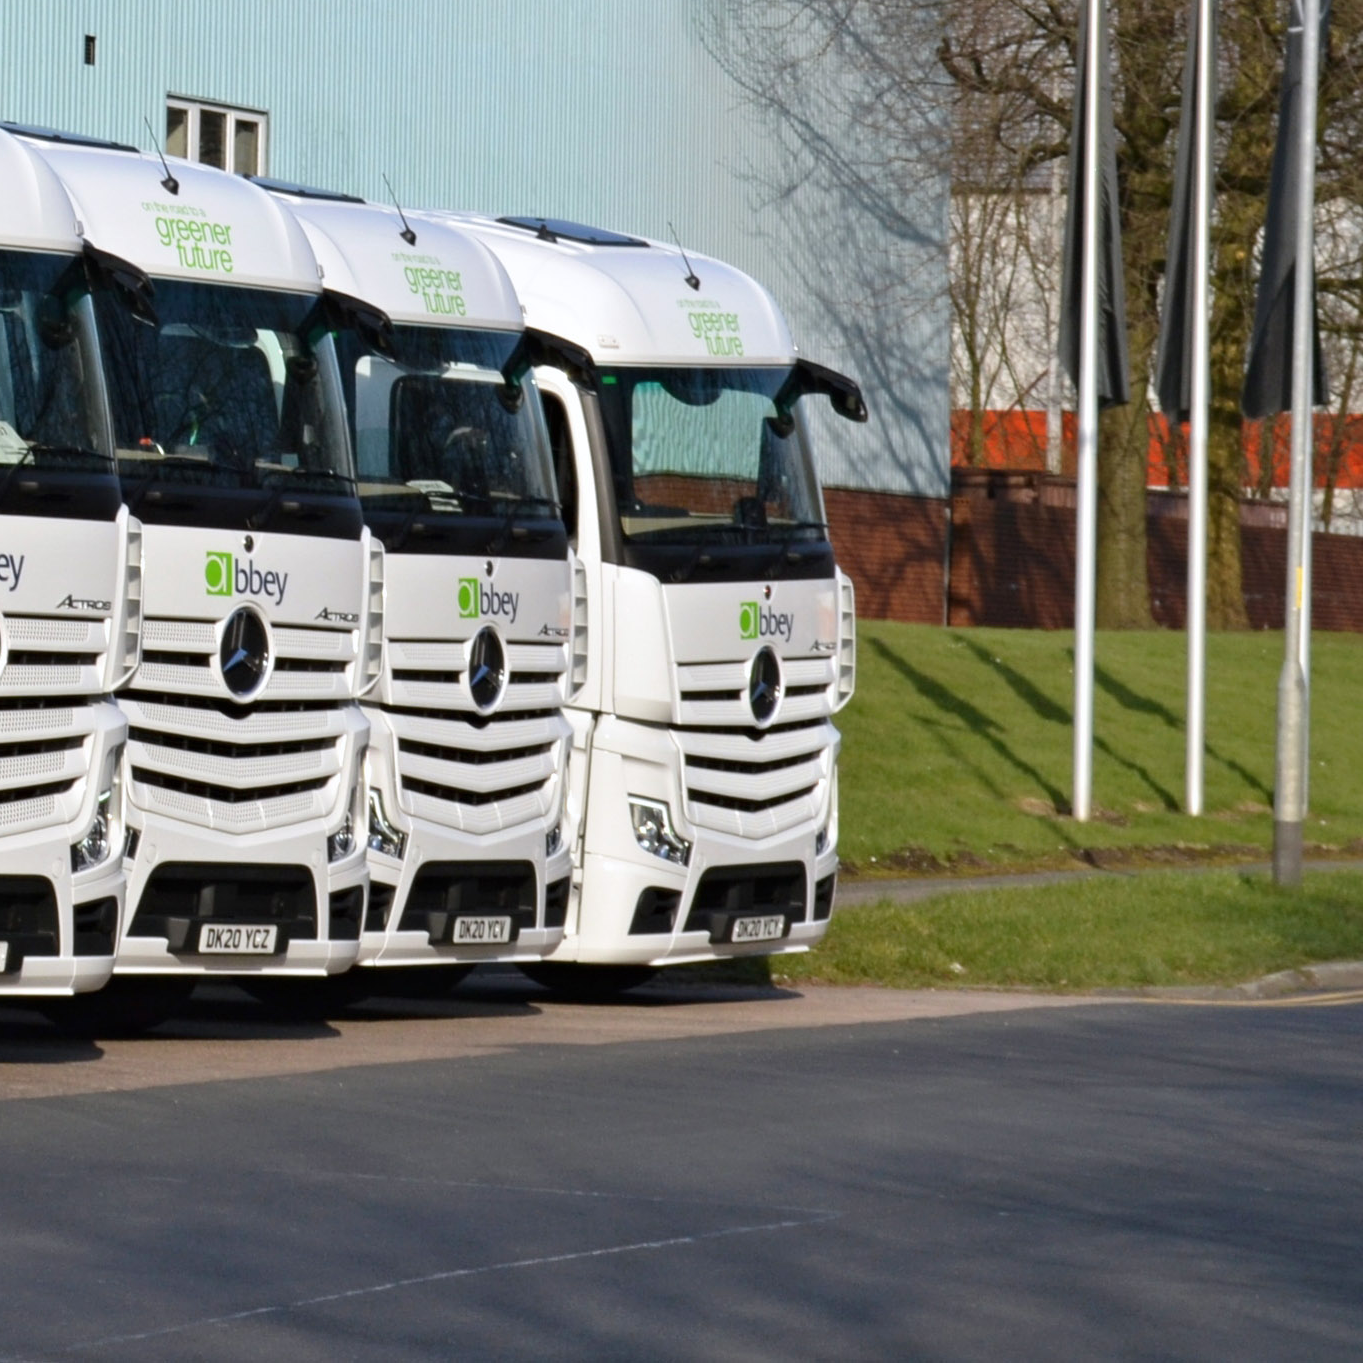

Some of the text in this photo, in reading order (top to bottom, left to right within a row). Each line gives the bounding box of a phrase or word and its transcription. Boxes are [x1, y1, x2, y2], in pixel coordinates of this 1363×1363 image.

[155, 217, 231, 246] greener
[176, 239, 233, 273] future
[404, 266, 462, 294] greener
[422, 286, 466, 316] future
[688, 312, 740, 338] greener
[704, 330, 743, 357] future
[204, 551, 288, 605] abbey
[56, 593, 111, 611] ACTROS
[458, 577, 519, 624] abbey
[739, 602, 794, 643] abbey
[206, 928, 270, 949] DK20 YCZ
[459, 920, 506, 939] DK20 YCV
[737, 919, 761, 938] DK20
